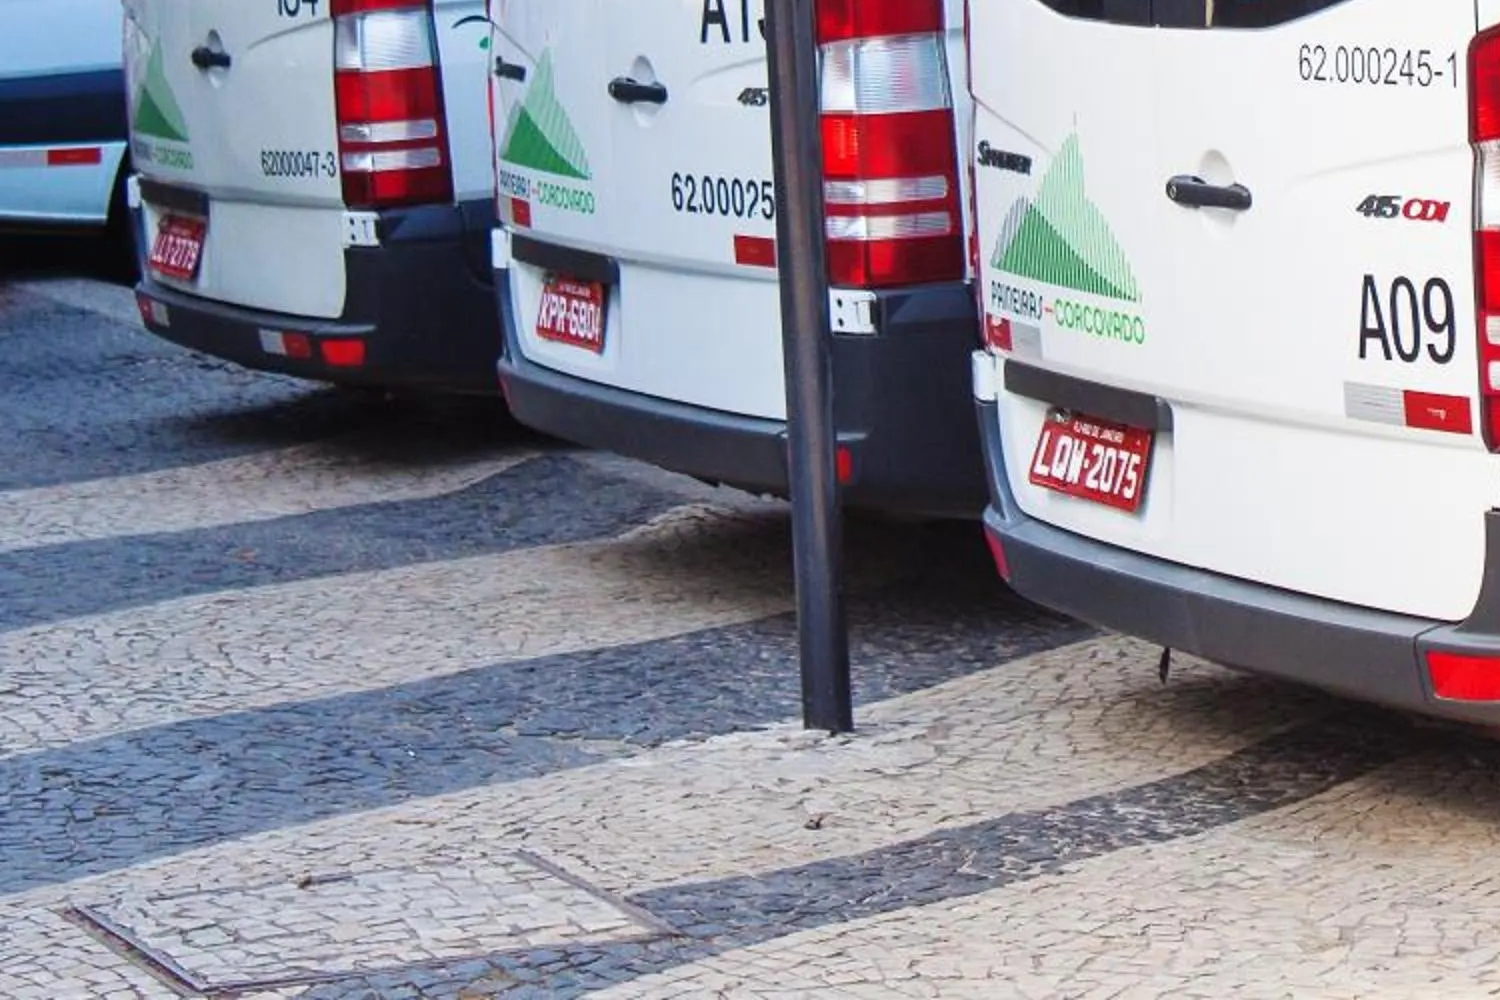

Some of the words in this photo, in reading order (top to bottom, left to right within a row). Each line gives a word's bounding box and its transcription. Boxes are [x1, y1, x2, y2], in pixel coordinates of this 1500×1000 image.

[1298, 44, 1458, 88] 62.000245-1
[1402, 198, 1451, 223] CDI
[1358, 274, 1456, 364] A09
